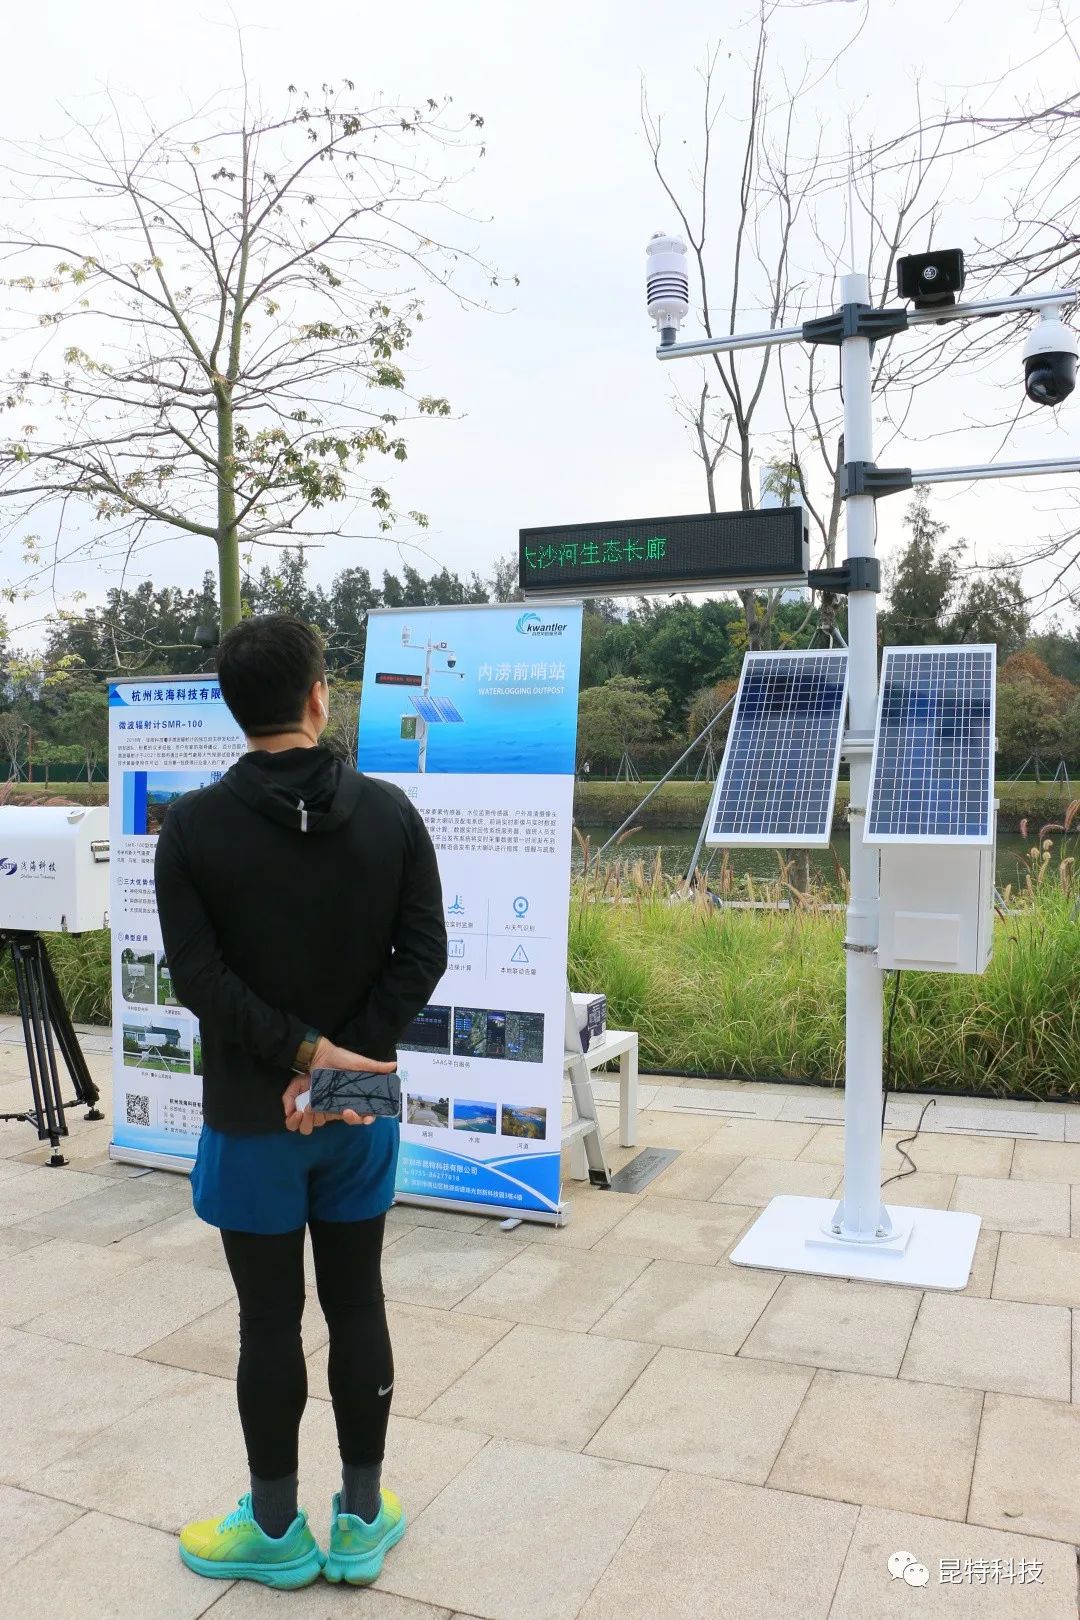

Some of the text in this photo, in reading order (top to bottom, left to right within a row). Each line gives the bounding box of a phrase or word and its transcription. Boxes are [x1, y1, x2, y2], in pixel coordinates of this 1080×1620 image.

[527, 623, 567, 632] kwantler
[478, 663, 566, 681] 内涝前哨站
[478, 686, 565, 696] WATERLOGGING OUTPOST
